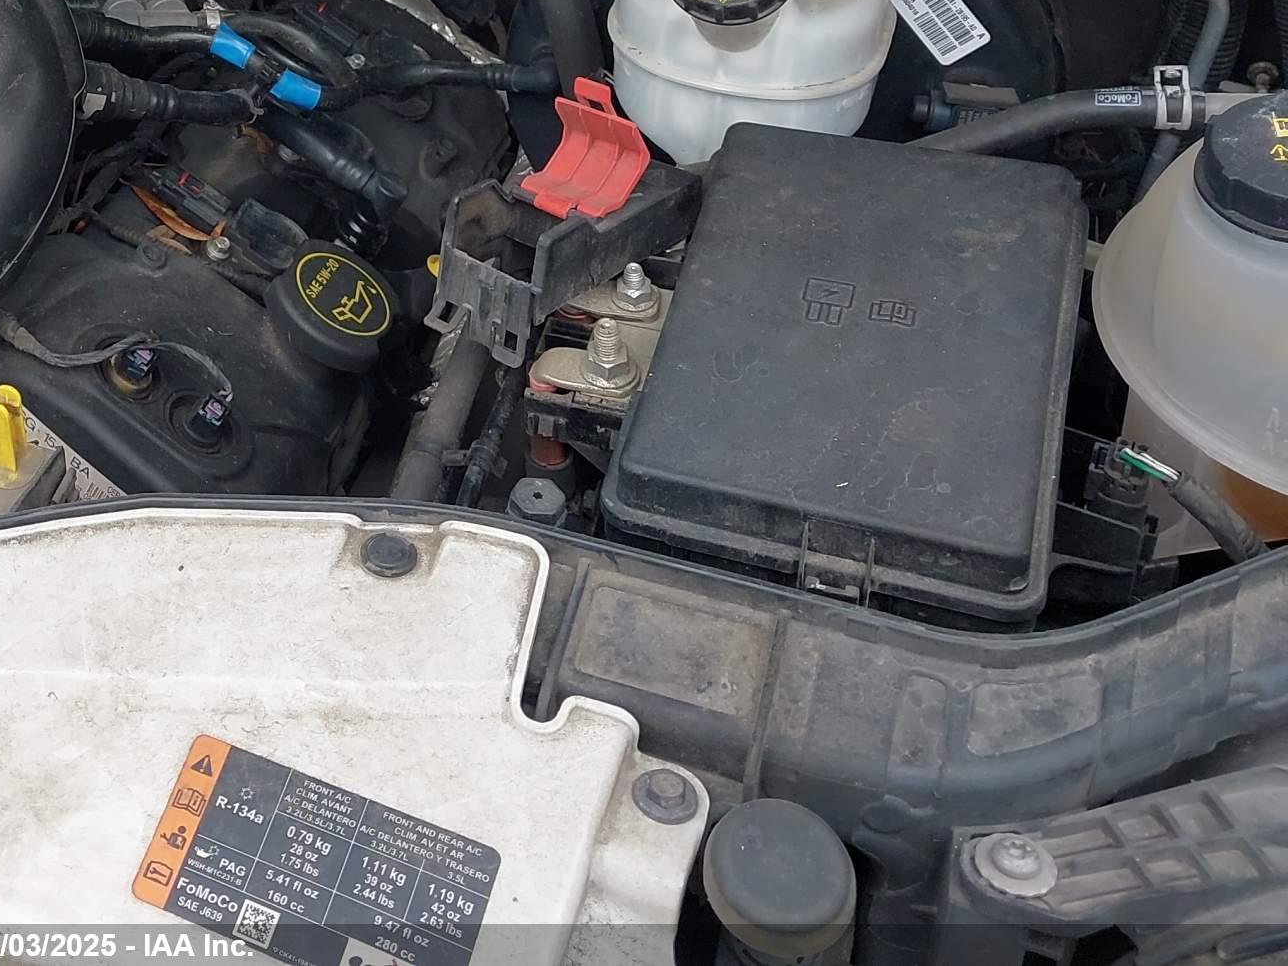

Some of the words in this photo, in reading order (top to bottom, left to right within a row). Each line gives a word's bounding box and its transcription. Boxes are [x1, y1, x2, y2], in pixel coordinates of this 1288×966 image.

[1098, 94, 1138, 103] FoMoCo
[305, 279, 324, 299] SAE
[315, 257, 340, 286] 5W-20
[69, 456, 94, 480] BA
[295, 787, 321, 803] CLIM.
[320, 797, 353, 816] AVANT
[303, 780, 335, 798] FRONT
[334, 792, 352, 805] A/C
[214, 795, 266, 825] R-134a
[283, 793, 301, 806] A/C
[300, 800, 357, 829] DELANTERO
[286, 825, 315, 846] 0.79
[313, 836, 333, 857] kg
[383, 811, 414, 829] FRONT
[415, 824, 437, 838] AND
[437, 833, 465, 850] REAR
[465, 844, 483, 857] A/C
[288, 842, 304, 857] 28
[304, 850, 319, 863] oz
[359, 824, 377, 837] A/C
[376, 831, 435, 860] DELANTERO
[434, 855, 443, 863] Y
[443, 858, 491, 884] TRASERO
[369, 840, 411, 862] 3.2L/3.7L
[420, 837, 435, 849] AV
[435, 843, 449, 854] ET
[449, 848, 465, 861] AR
[218, 858, 247, 877] PAG
[278, 852, 302, 870] 1.75
[302, 862, 321, 878] lbs
[360, 856, 388, 876] 1.11
[387, 867, 408, 887] kg
[447, 871, 467, 885] 3.5L
[175, 876, 241, 913] FoMoCo
[265, 869, 291, 887] 5.41
[292, 880, 303, 892] fl
[302, 886, 320, 900] oz
[352, 883, 377, 901] 2.44
[377, 893, 397, 909] lbs
[363, 873, 379, 887] 39
[378, 881, 394, 894] oz
[177, 895, 200, 912] SAE
[199, 905, 224, 923] J639
[265, 889, 289, 906] 160
[289, 901, 306, 914] cc
[426, 883, 457, 904] 1.19
[454, 895, 476, 916] kg
[430, 901, 446, 916] 42
[445, 909, 462, 923] oz
[372, 914, 401, 934] 9.47
[401, 927, 413, 940] fl
[412, 934, 431, 948] oz
[419, 911, 445, 930] 2.63
[444, 922, 465, 939] lbs
[374, 936, 399, 954] 280
[399, 948, 417, 962] cc
